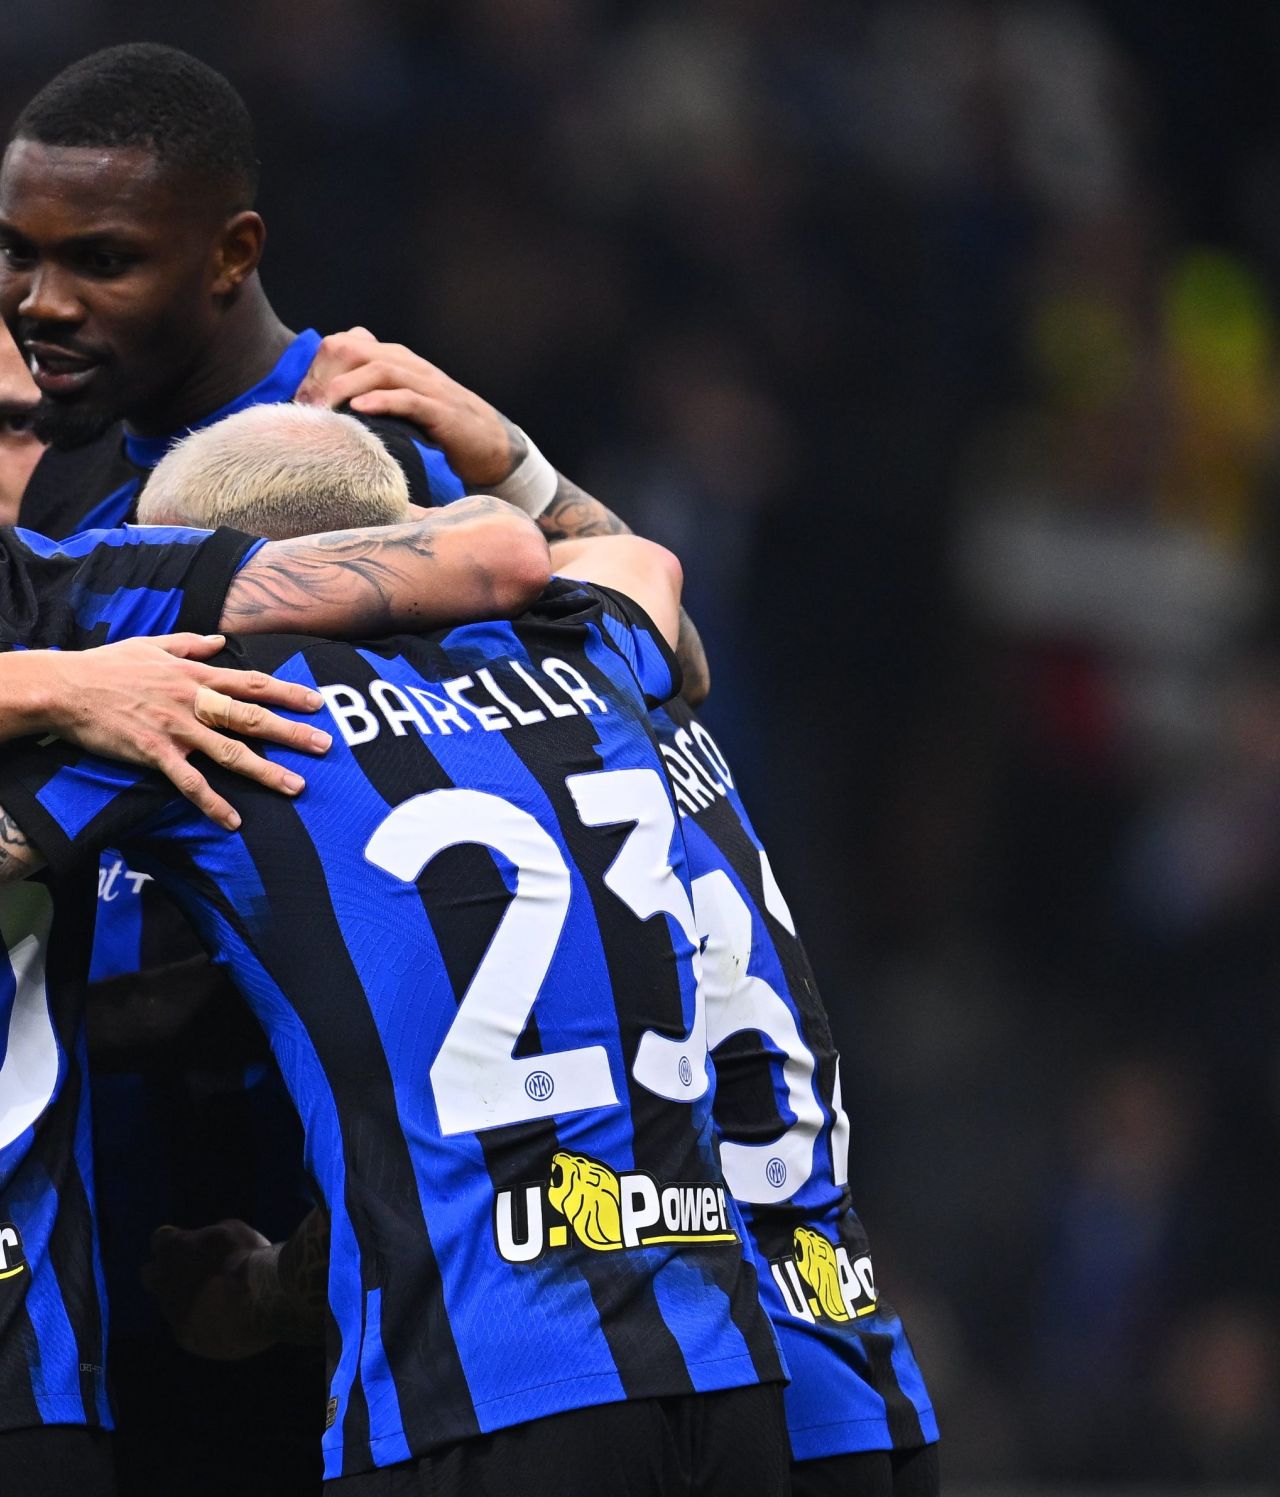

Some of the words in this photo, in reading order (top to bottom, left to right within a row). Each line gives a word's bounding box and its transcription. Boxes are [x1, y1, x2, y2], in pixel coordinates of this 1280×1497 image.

[318, 657, 608, 747] BARELLA
[364, 768, 711, 1136] 23
[622, 1174, 728, 1247] Power
